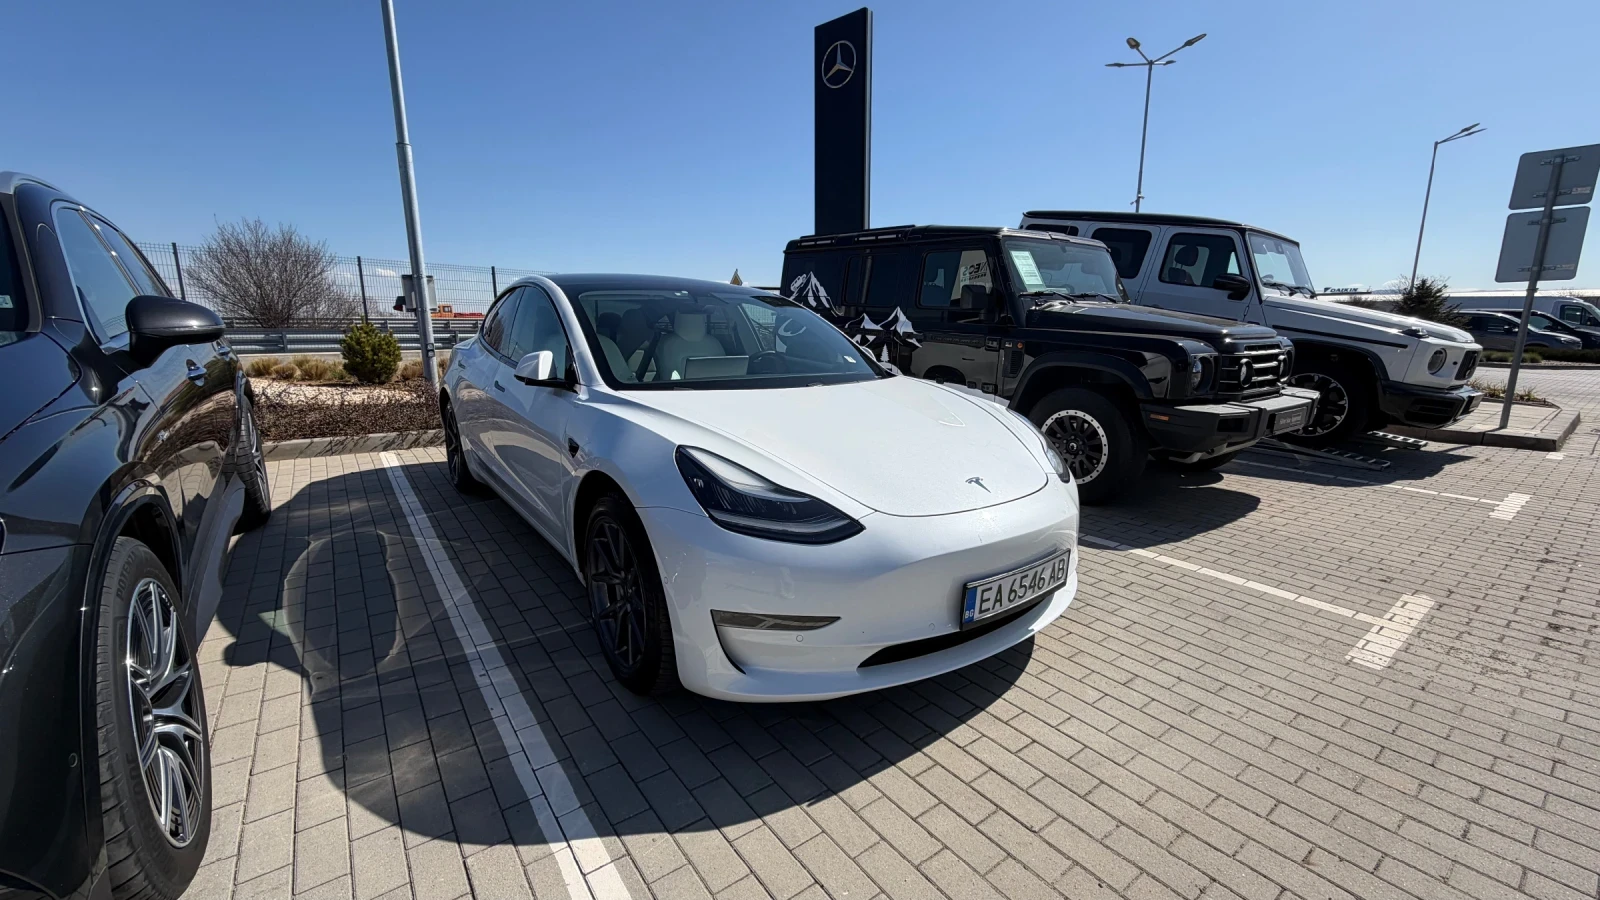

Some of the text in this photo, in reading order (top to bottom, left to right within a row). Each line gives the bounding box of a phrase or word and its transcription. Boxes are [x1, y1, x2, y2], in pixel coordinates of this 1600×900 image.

[979, 558, 1066, 615] EA 6546 AB
[964, 609, 975, 619] BG
